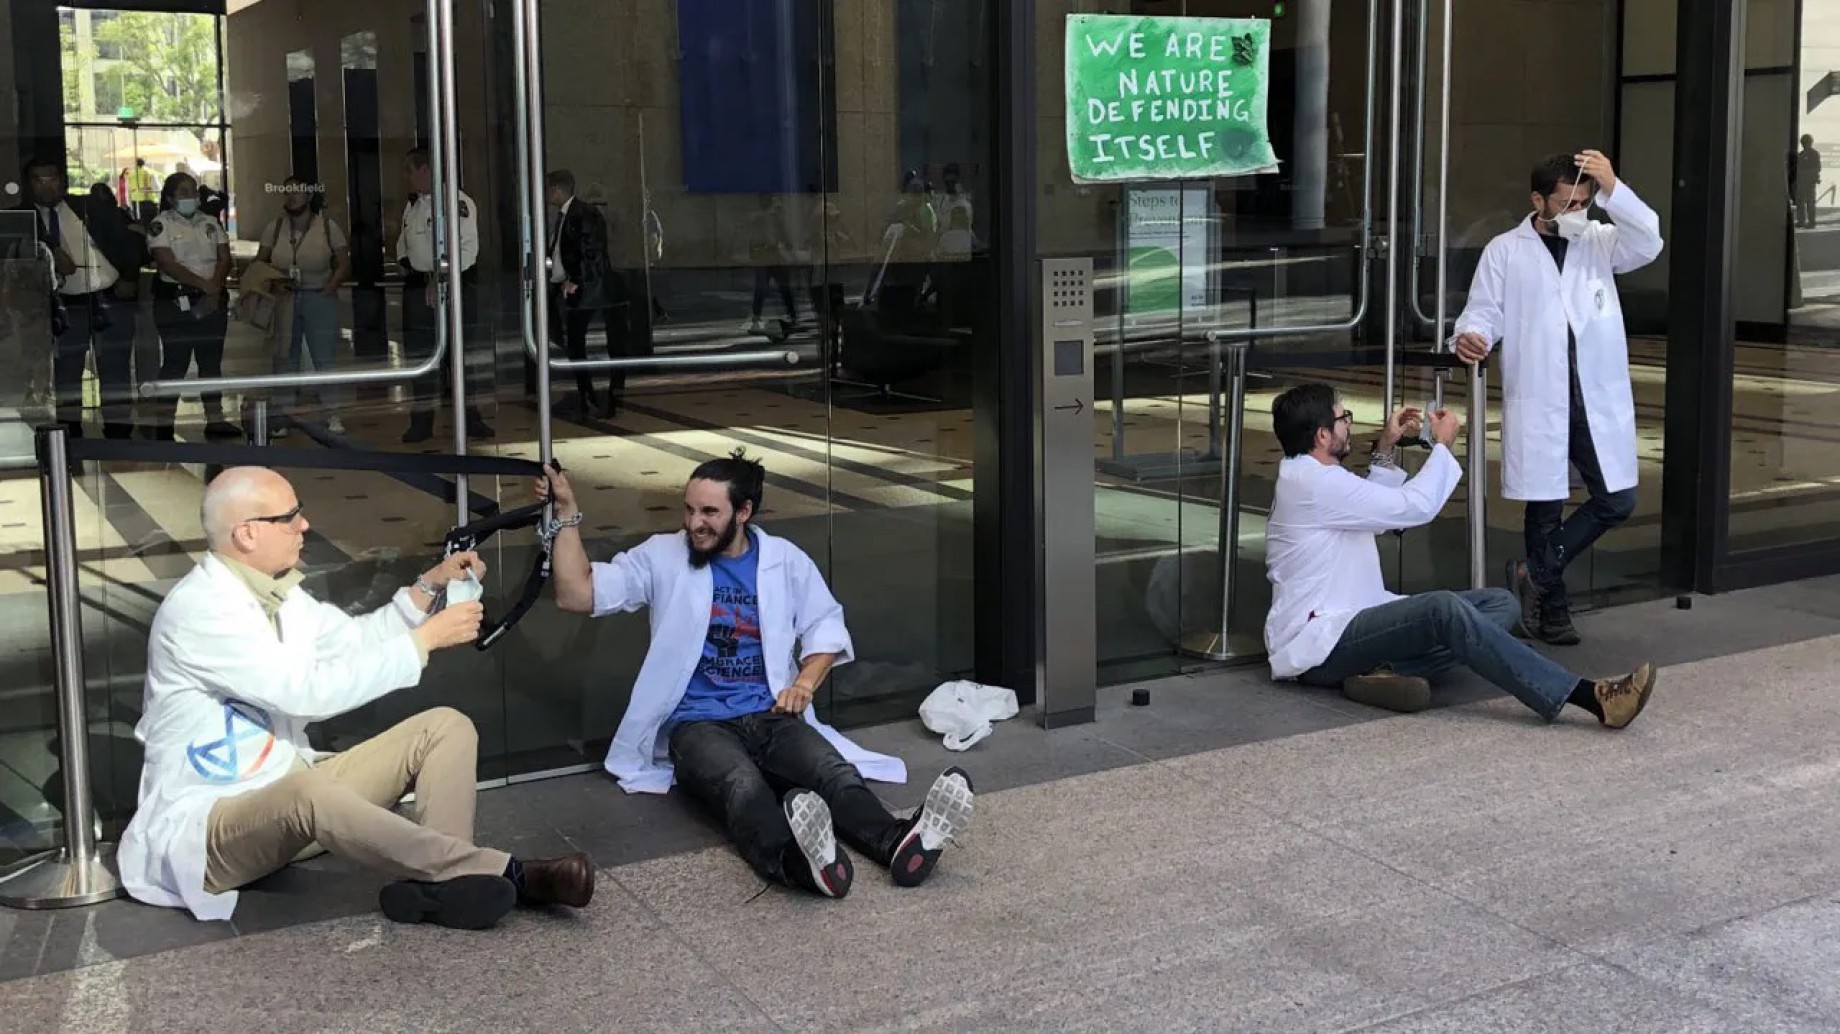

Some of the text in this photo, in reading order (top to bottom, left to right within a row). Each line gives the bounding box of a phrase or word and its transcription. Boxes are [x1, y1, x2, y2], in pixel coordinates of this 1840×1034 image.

[1086, 32, 1226, 61] WE ARE
[1119, 69, 1233, 98] NATURE
[1088, 98, 1249, 124] DEFENDING
[1089, 132, 1215, 162] ITSELF
[264, 183, 326, 192] Brookfield
